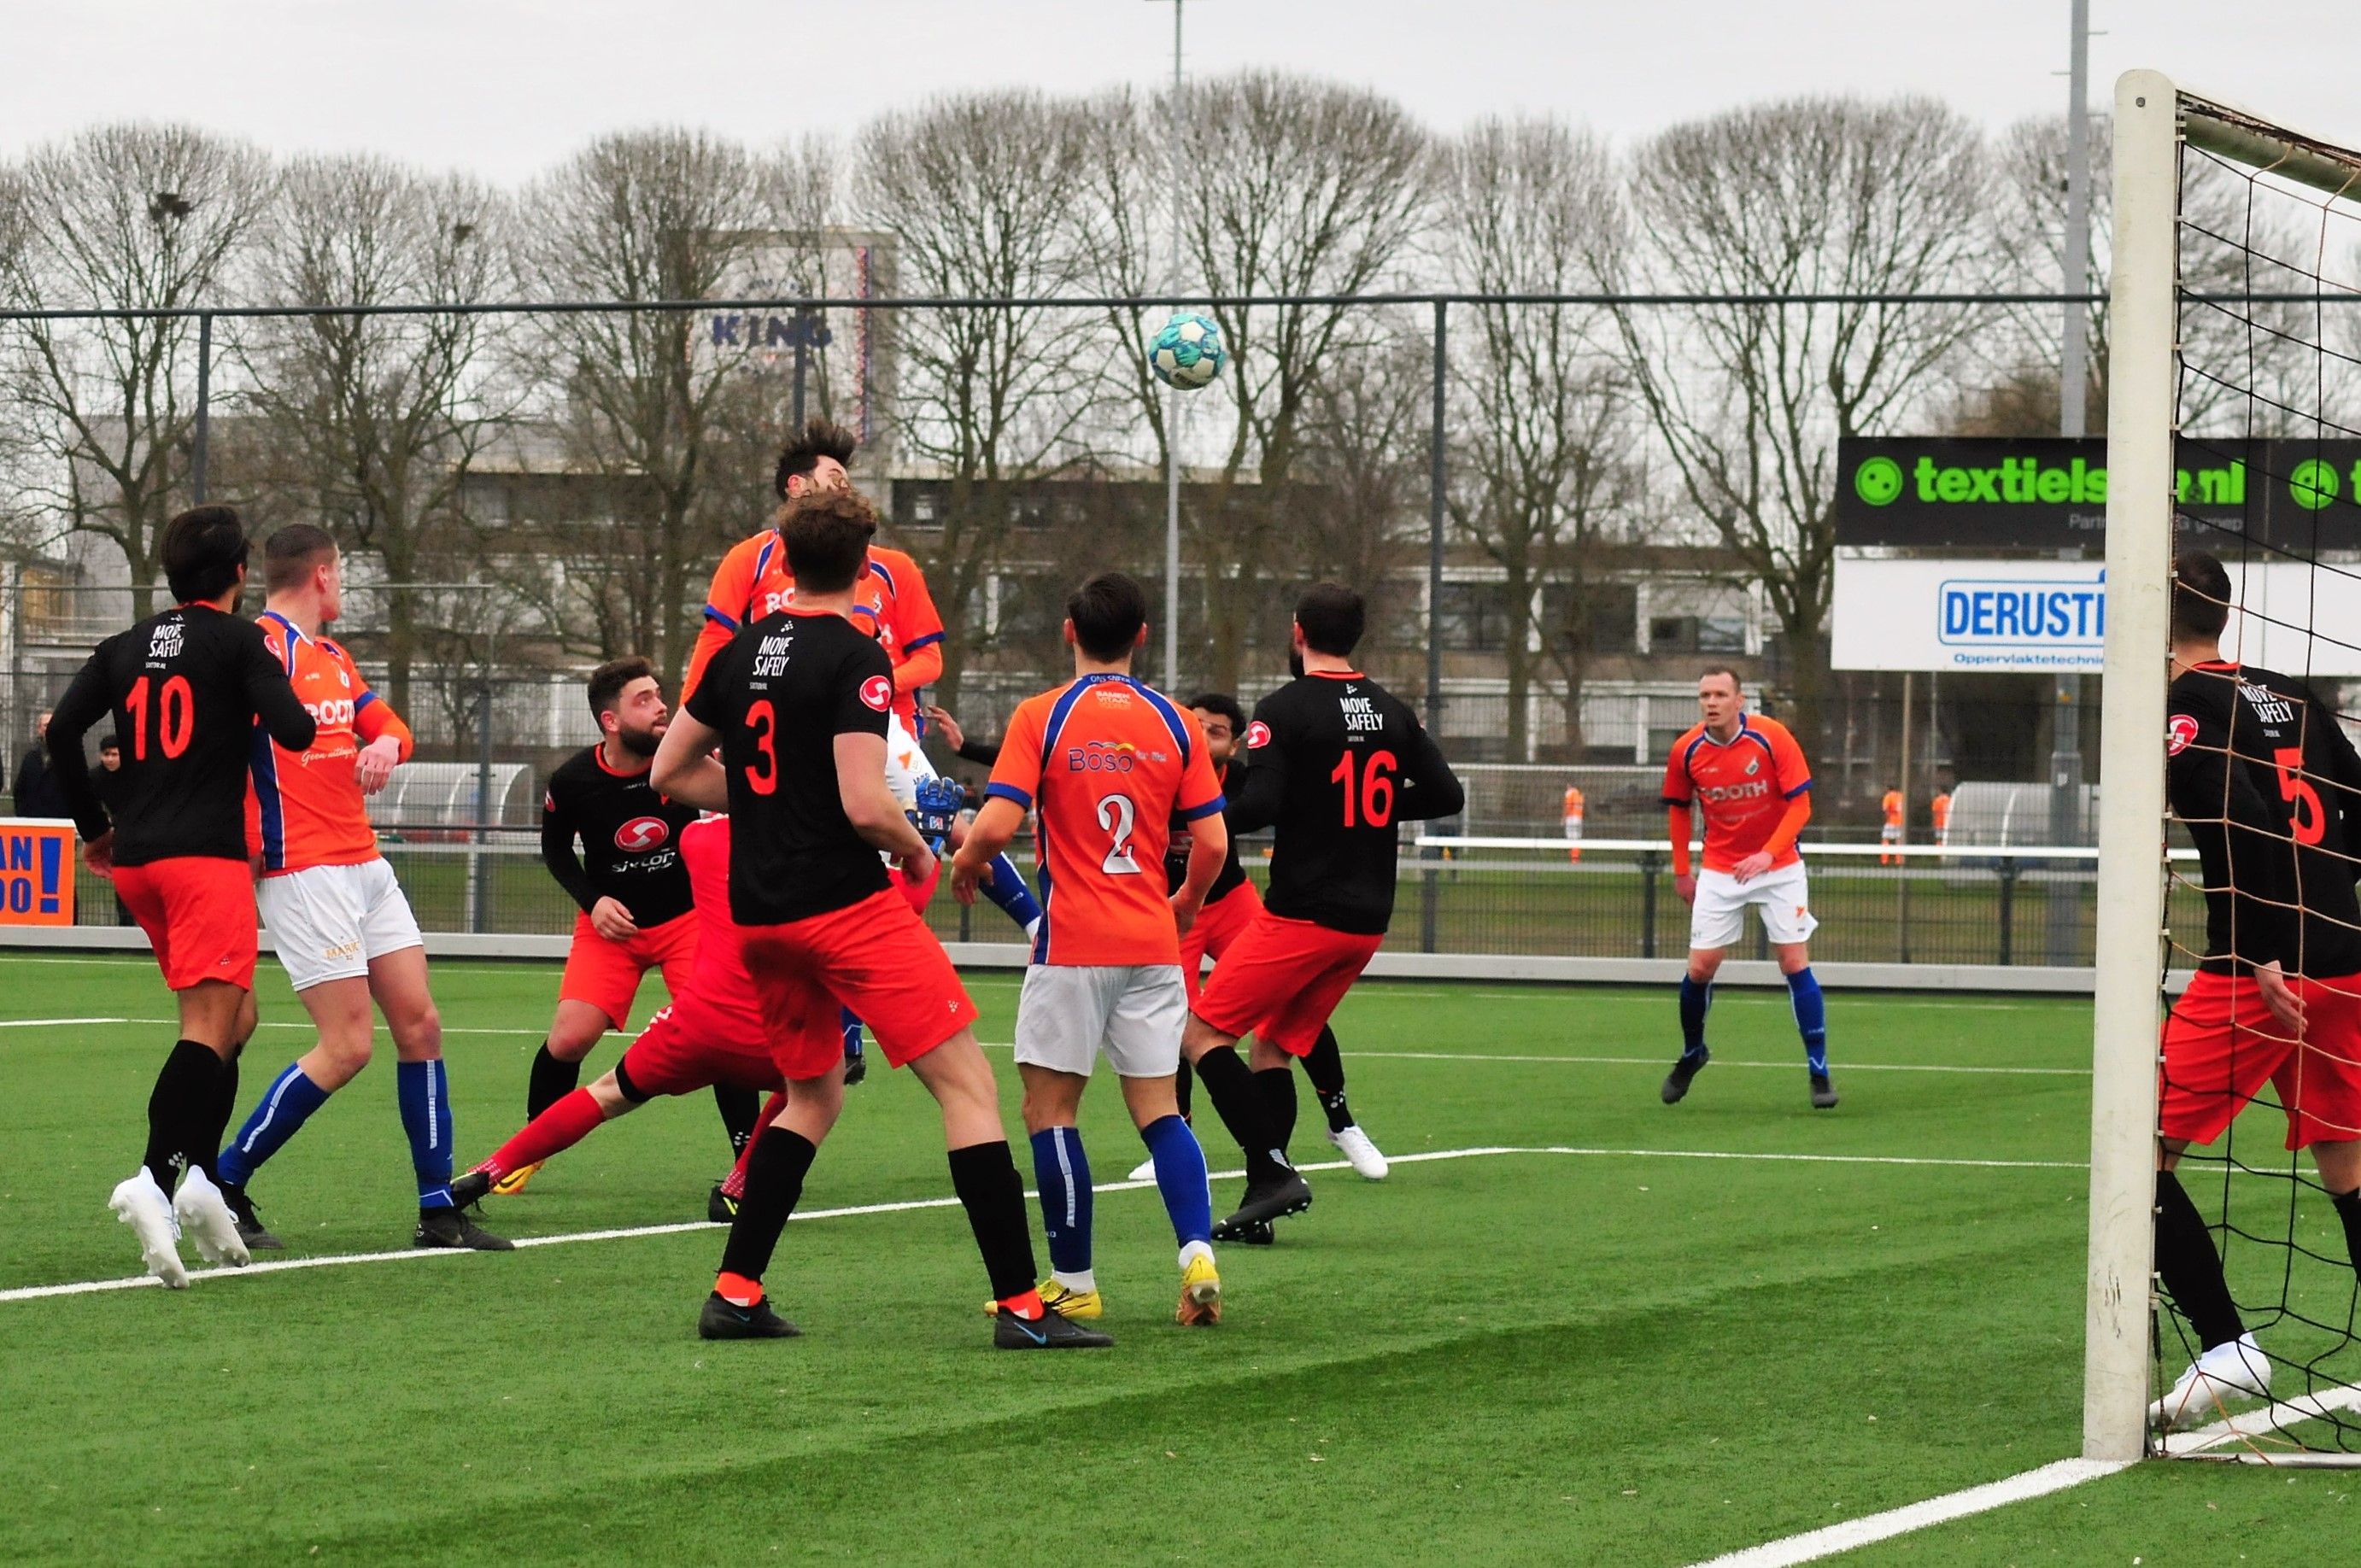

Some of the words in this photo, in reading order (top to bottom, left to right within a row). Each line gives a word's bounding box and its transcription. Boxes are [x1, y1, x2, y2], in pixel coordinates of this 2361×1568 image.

[1945, 590, 2106, 637] DERUSTI
[759, 635, 794, 655] MOVE
[753, 656, 790, 676] SAFELY
[1339, 698, 1374, 714] MOVE
[2237, 684, 2278, 703] MOVE
[126, 675, 194, 761] 10
[1345, 714, 1383, 731] SAFELY
[2252, 701, 2294, 723] SAFELY
[745, 699, 777, 796] 3
[1332, 750, 1397, 828] 16
[2273, 746, 2325, 845] 5
[1097, 793, 1142, 875] 2
